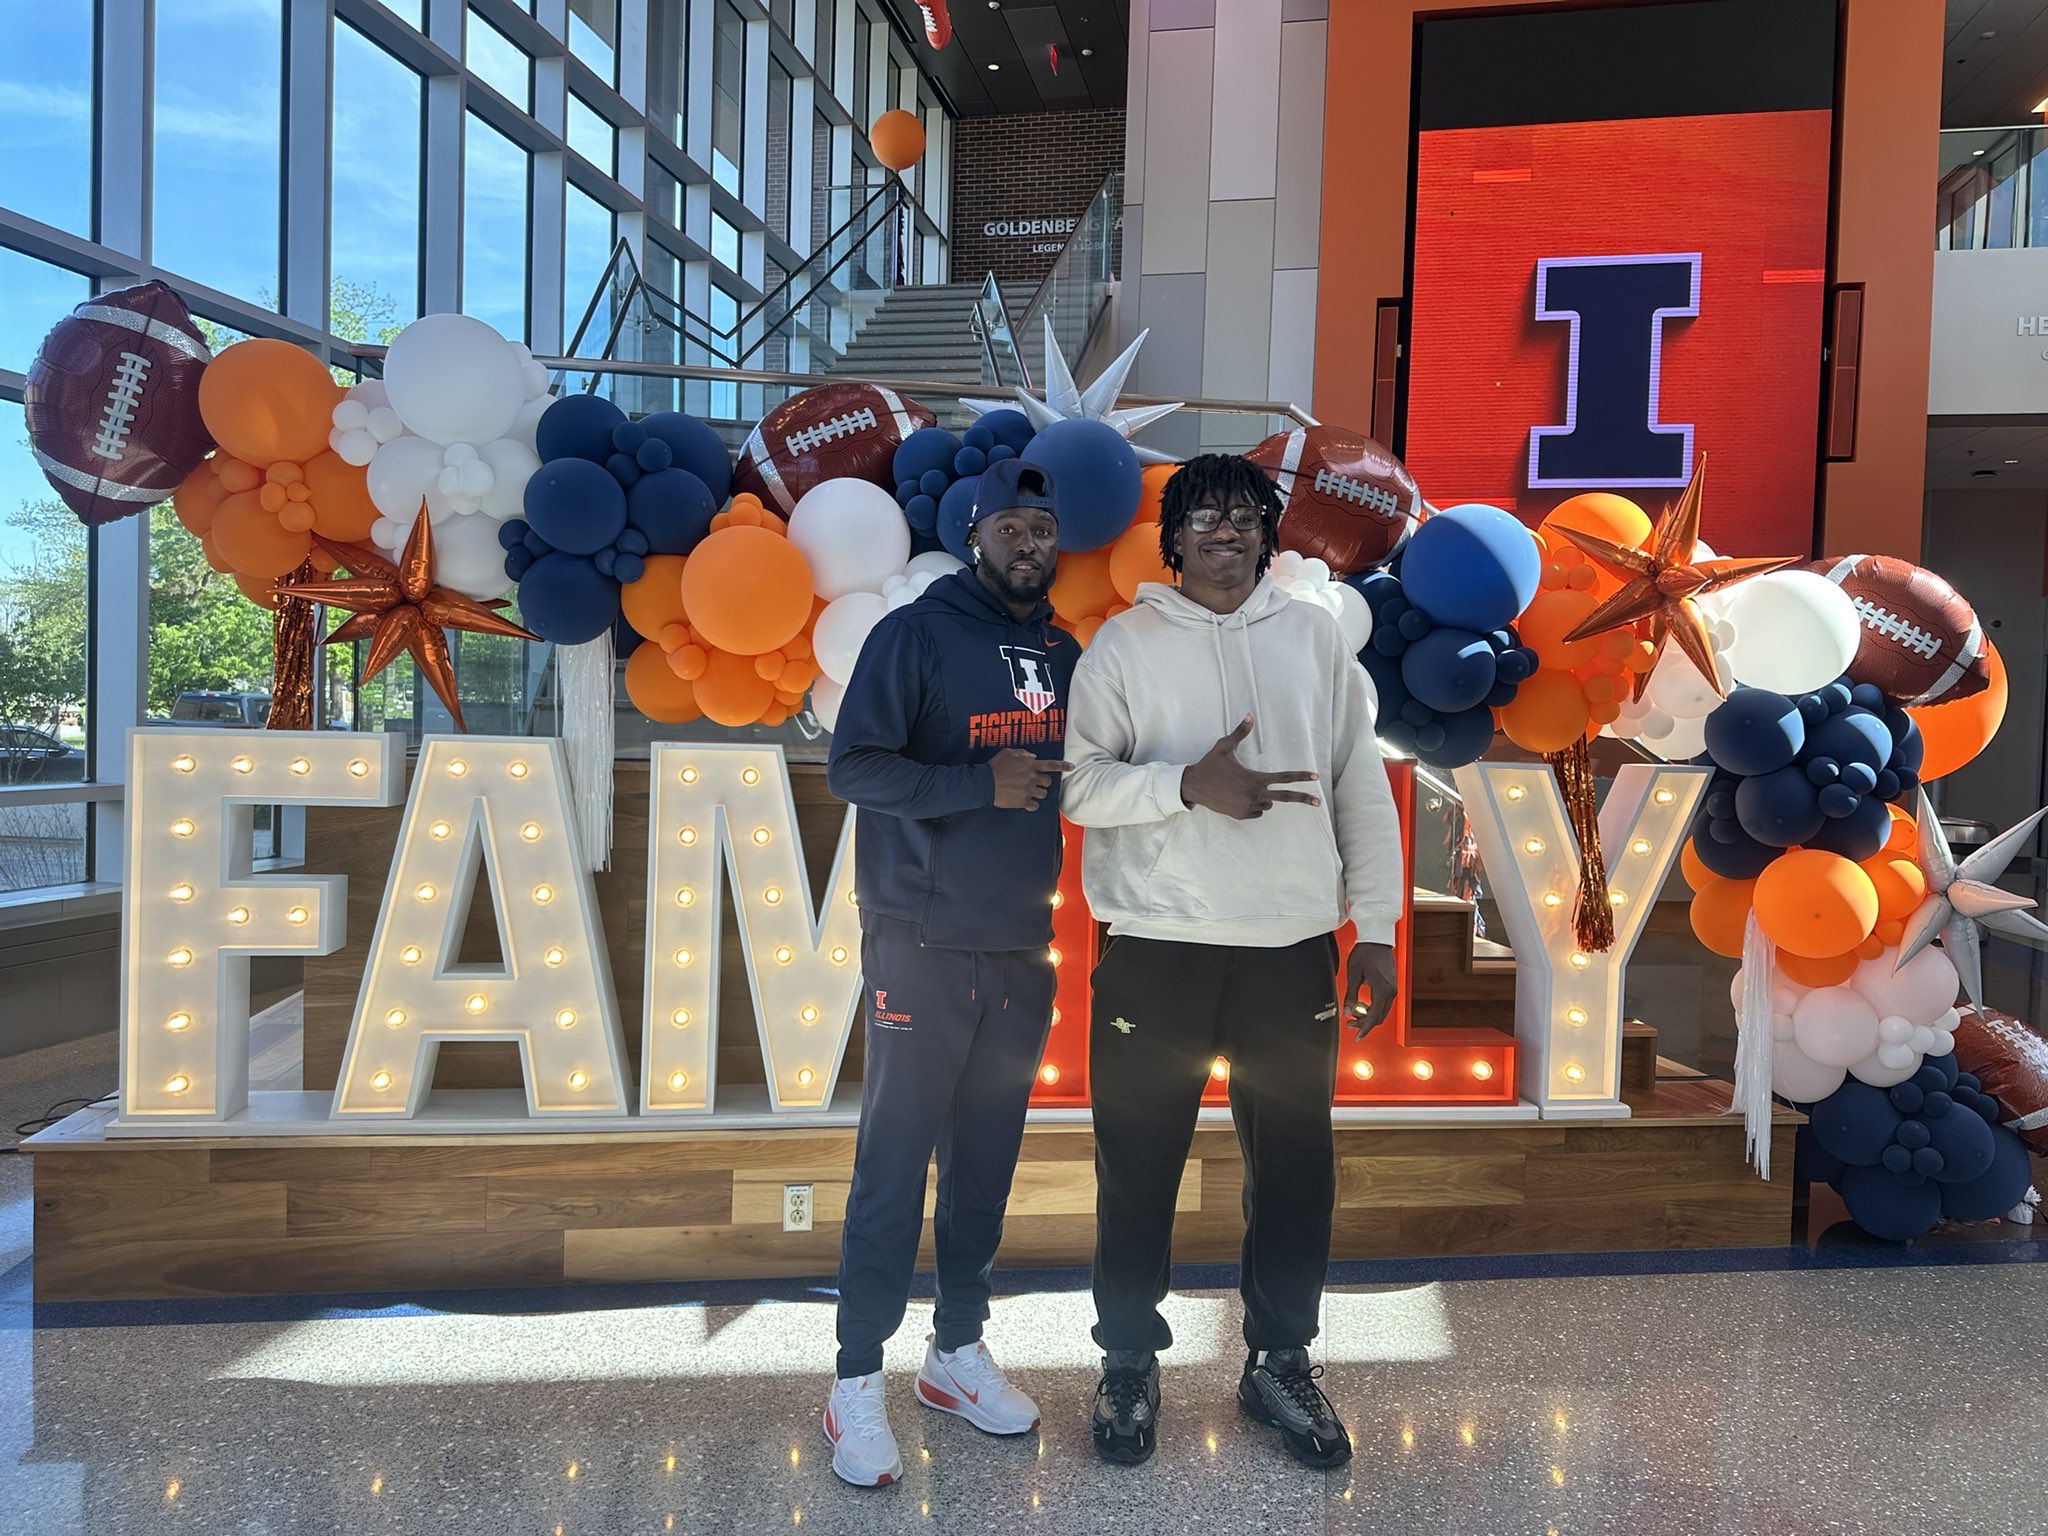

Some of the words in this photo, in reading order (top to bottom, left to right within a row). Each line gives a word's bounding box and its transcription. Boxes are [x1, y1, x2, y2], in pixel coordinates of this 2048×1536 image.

[1528, 252, 1702, 489] I
[969, 711, 1046, 749] FIGHTING
[876, 990, 887, 1009] I
[875, 1010, 912, 1022] ILLINOIS
